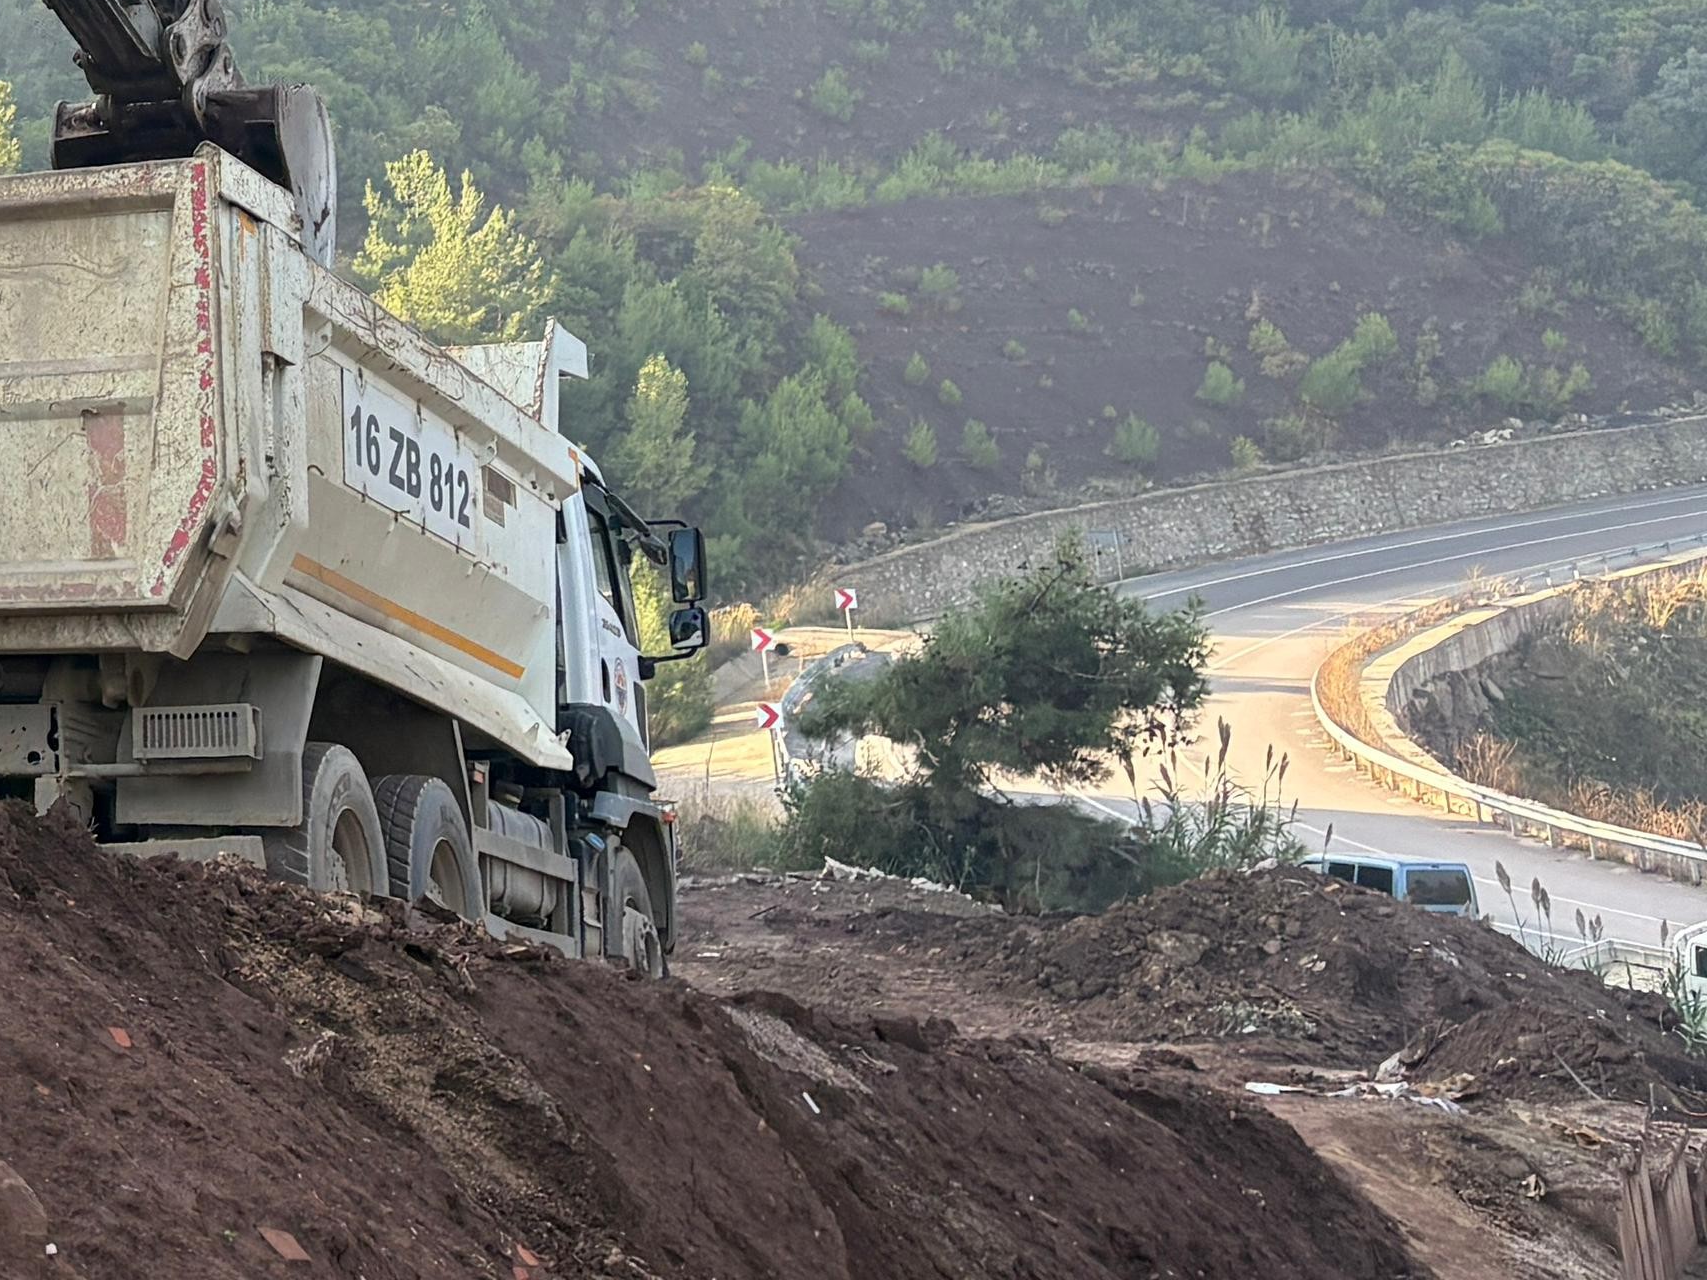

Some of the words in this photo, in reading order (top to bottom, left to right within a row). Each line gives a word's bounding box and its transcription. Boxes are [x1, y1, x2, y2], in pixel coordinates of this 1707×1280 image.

[350, 404, 381, 476] 16
[388, 426, 422, 499] ZB
[429, 452, 470, 529] 812
